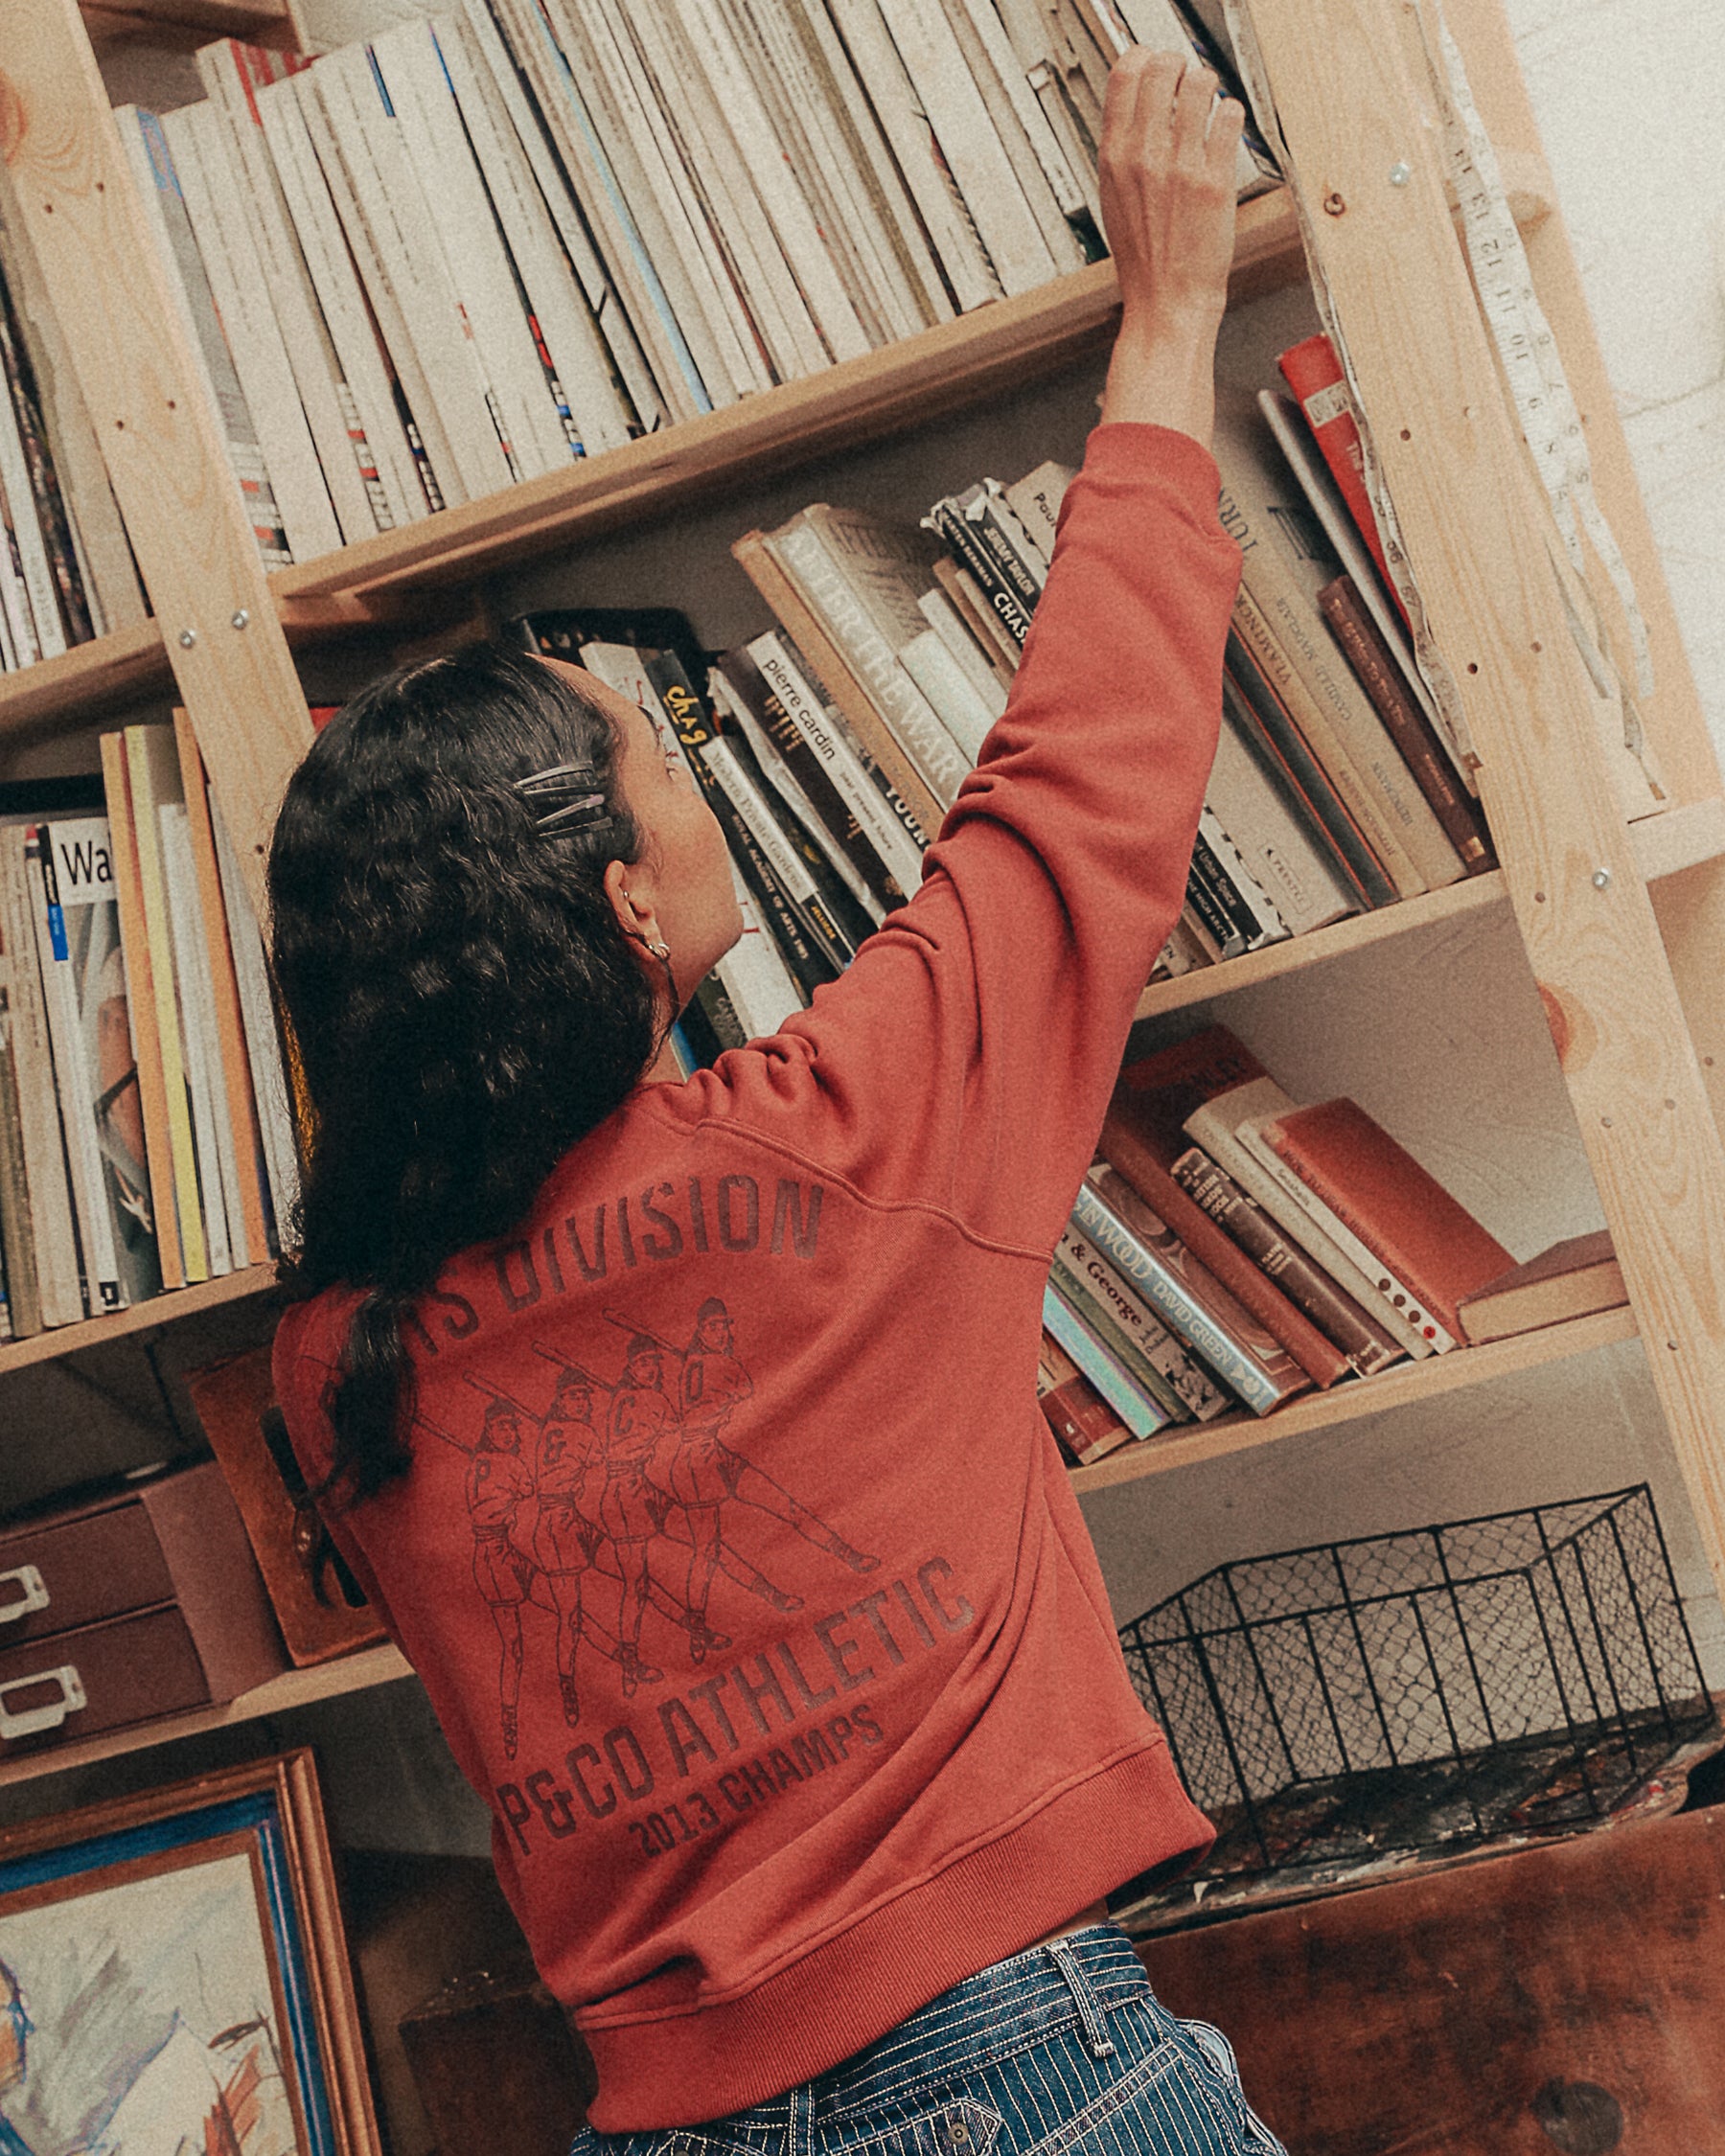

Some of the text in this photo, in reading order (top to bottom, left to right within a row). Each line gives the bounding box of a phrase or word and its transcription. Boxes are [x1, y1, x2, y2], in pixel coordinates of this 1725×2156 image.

[1481, 239, 1503, 267] 12
[1496, 288, 1517, 313] 11
[1510, 333, 1530, 360] 10
[1006, 559, 1036, 597] TAYLOR
[1233, 592, 1293, 686] VLAMINCK
[761, 655, 805, 710] pierre
[795, 705, 840, 761] cardin
[847, 631, 912, 706] THE
[891, 700, 962, 784] WAR
[778, 906, 797, 938] ARTS
[1208, 913, 1231, 942] ARCTI
[1215, 877, 1238, 908] Space
[493, 1174, 824, 1314] DIVISION
[1096, 1216, 1153, 1279] WOOD
[1070, 1244, 1143, 1327] & George
[1153, 1280, 1233, 1365] DAVID GREEN
[496, 1555, 976, 1857] P&CO ATHLETIC
[628, 1704, 886, 1859] 2013 CHAMPS
